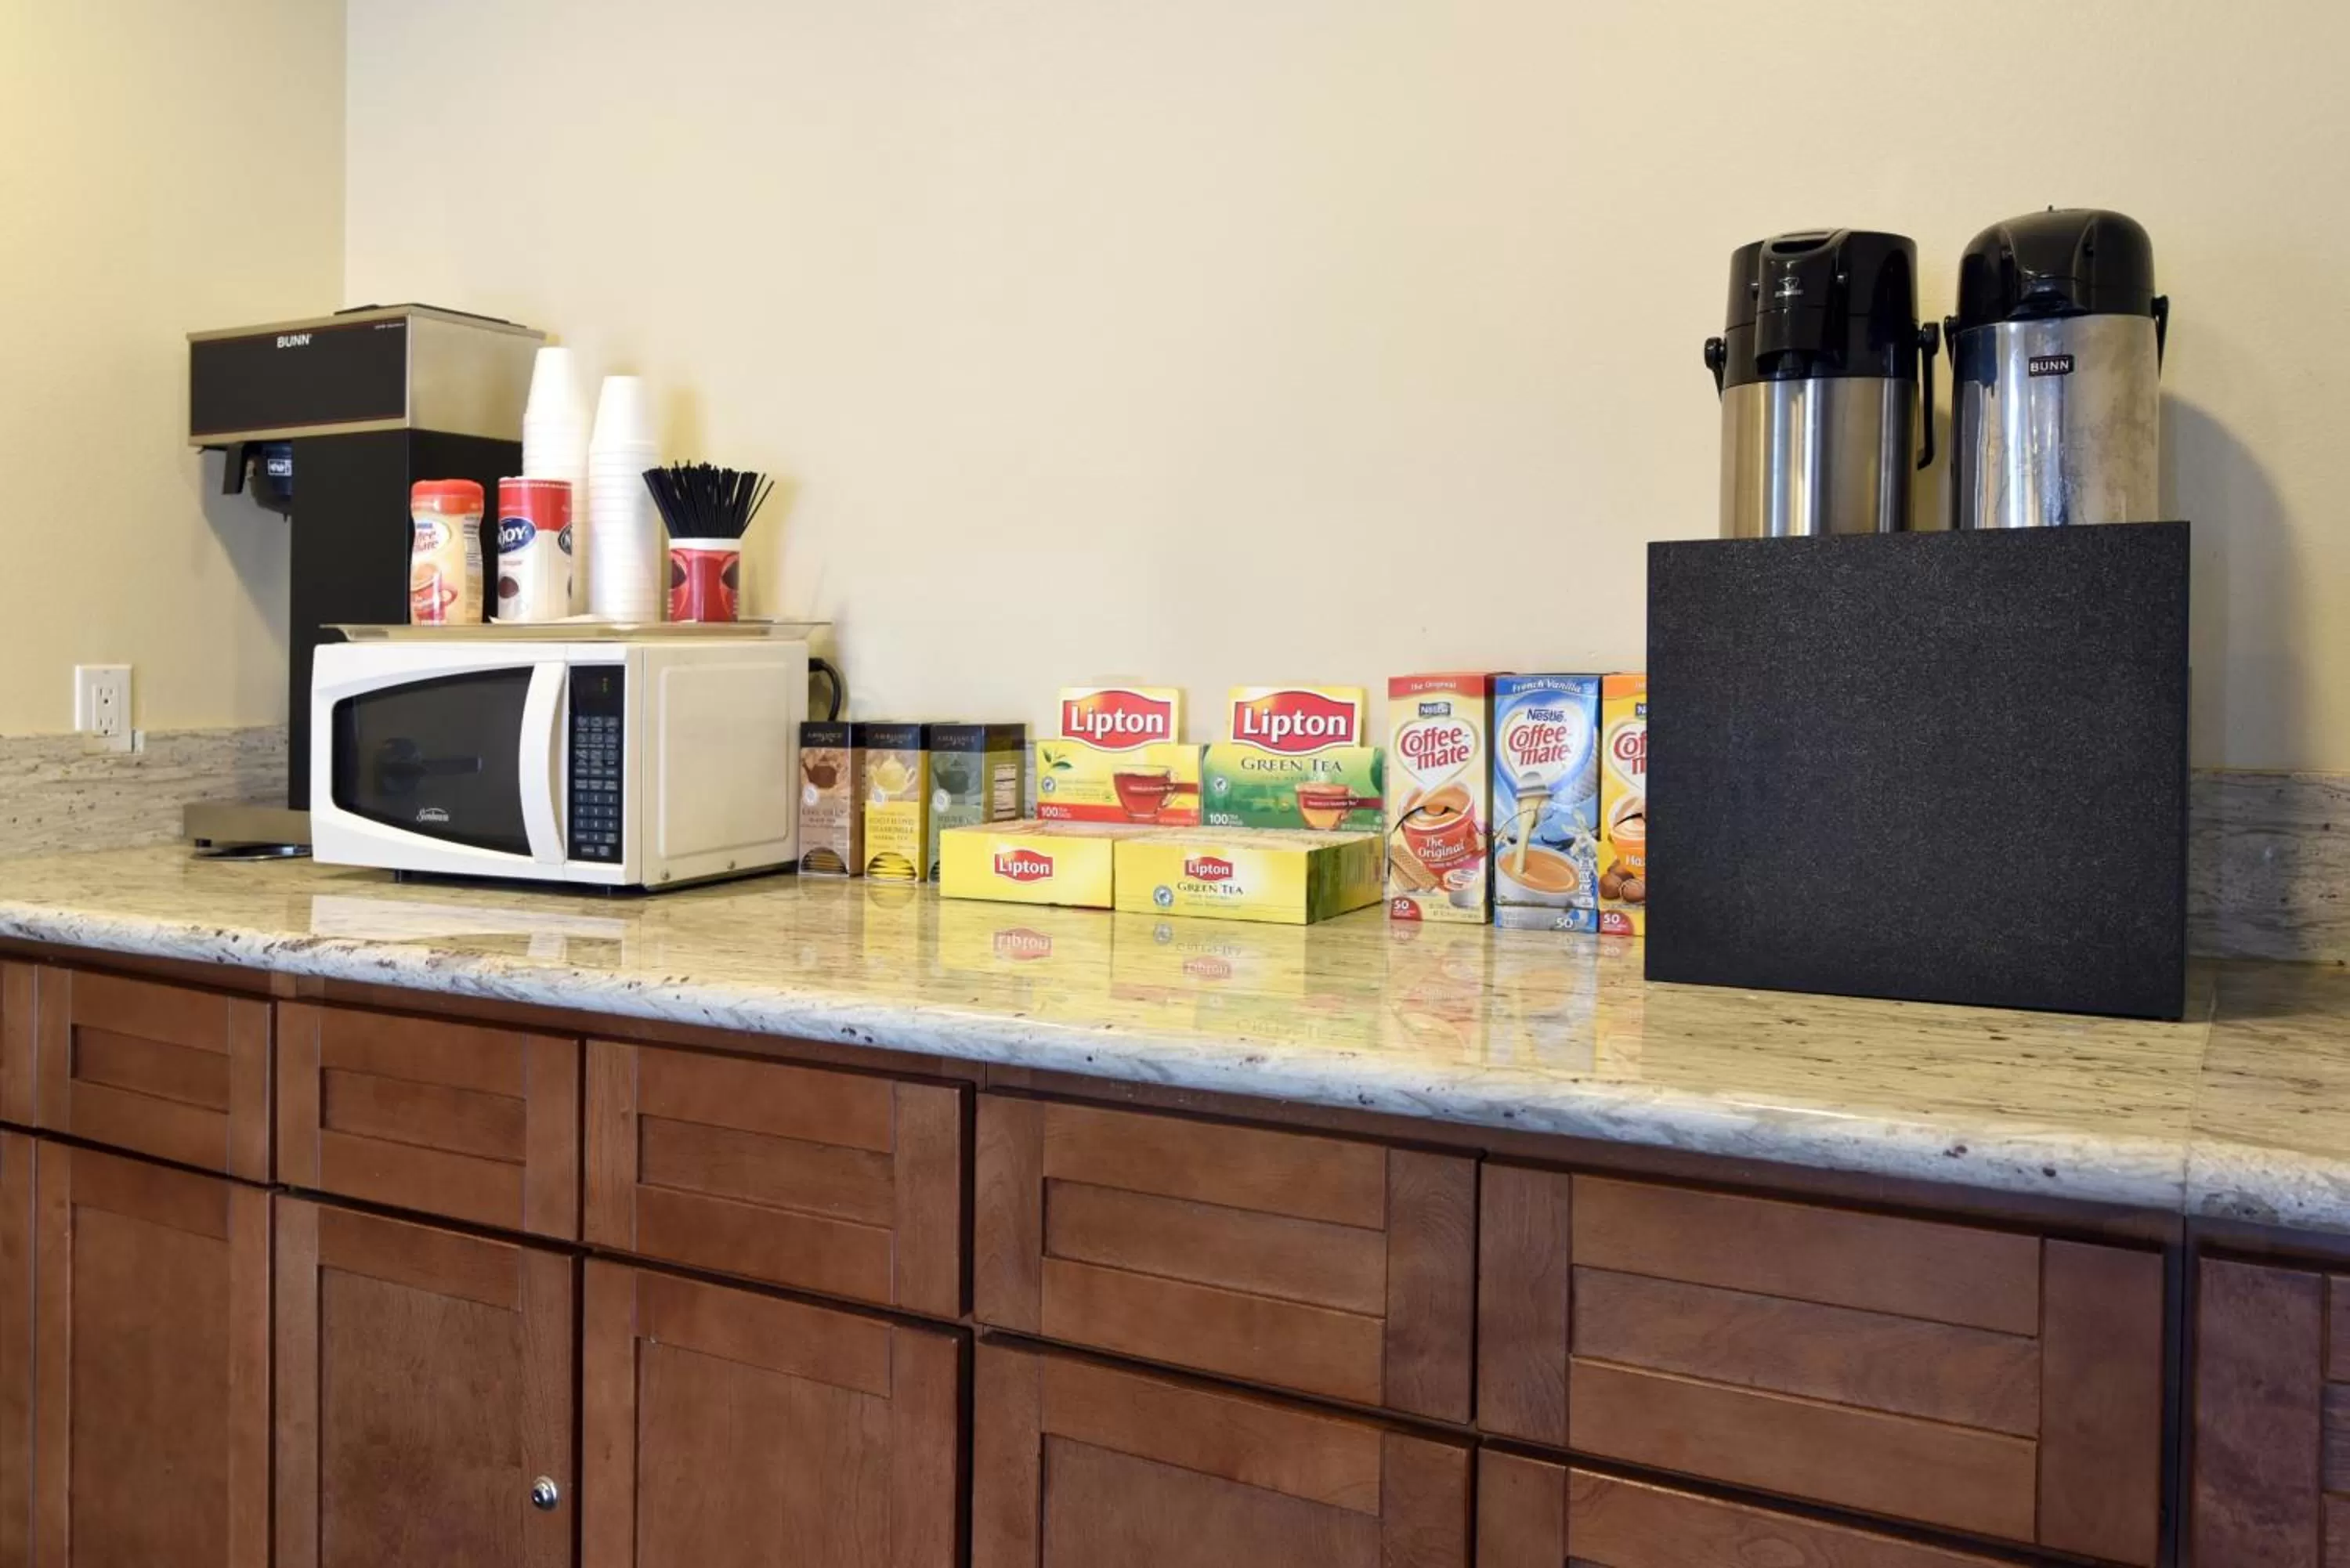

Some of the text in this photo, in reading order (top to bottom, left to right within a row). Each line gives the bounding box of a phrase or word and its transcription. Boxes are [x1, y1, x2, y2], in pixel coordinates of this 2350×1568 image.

[277, 334, 310, 349] BUNN
[2030, 360, 2069, 372] BUNN
[1513, 680, 1545, 693] French
[1546, 679, 1582, 693] Vanilla
[1070, 705, 1163, 740] Lipton
[1243, 706, 1347, 743] Lipton
[1417, 744, 1470, 771] mate
[1519, 743, 1571, 767] mate
[1241, 757, 1343, 773] GREEN TEA
[1042, 806, 1058, 818] 100
[1209, 813, 1228, 825] 100
[1426, 836, 1443, 847] The
[1418, 838, 1466, 860] Original
[999, 856, 1050, 876] Lipton
[1188, 862, 1230, 876] Lipton
[1177, 882, 1244, 896] GREEN TEA
[1394, 899, 1409, 909] 50
[1555, 917, 1574, 929] 50
[1603, 913, 1620, 924] 50
